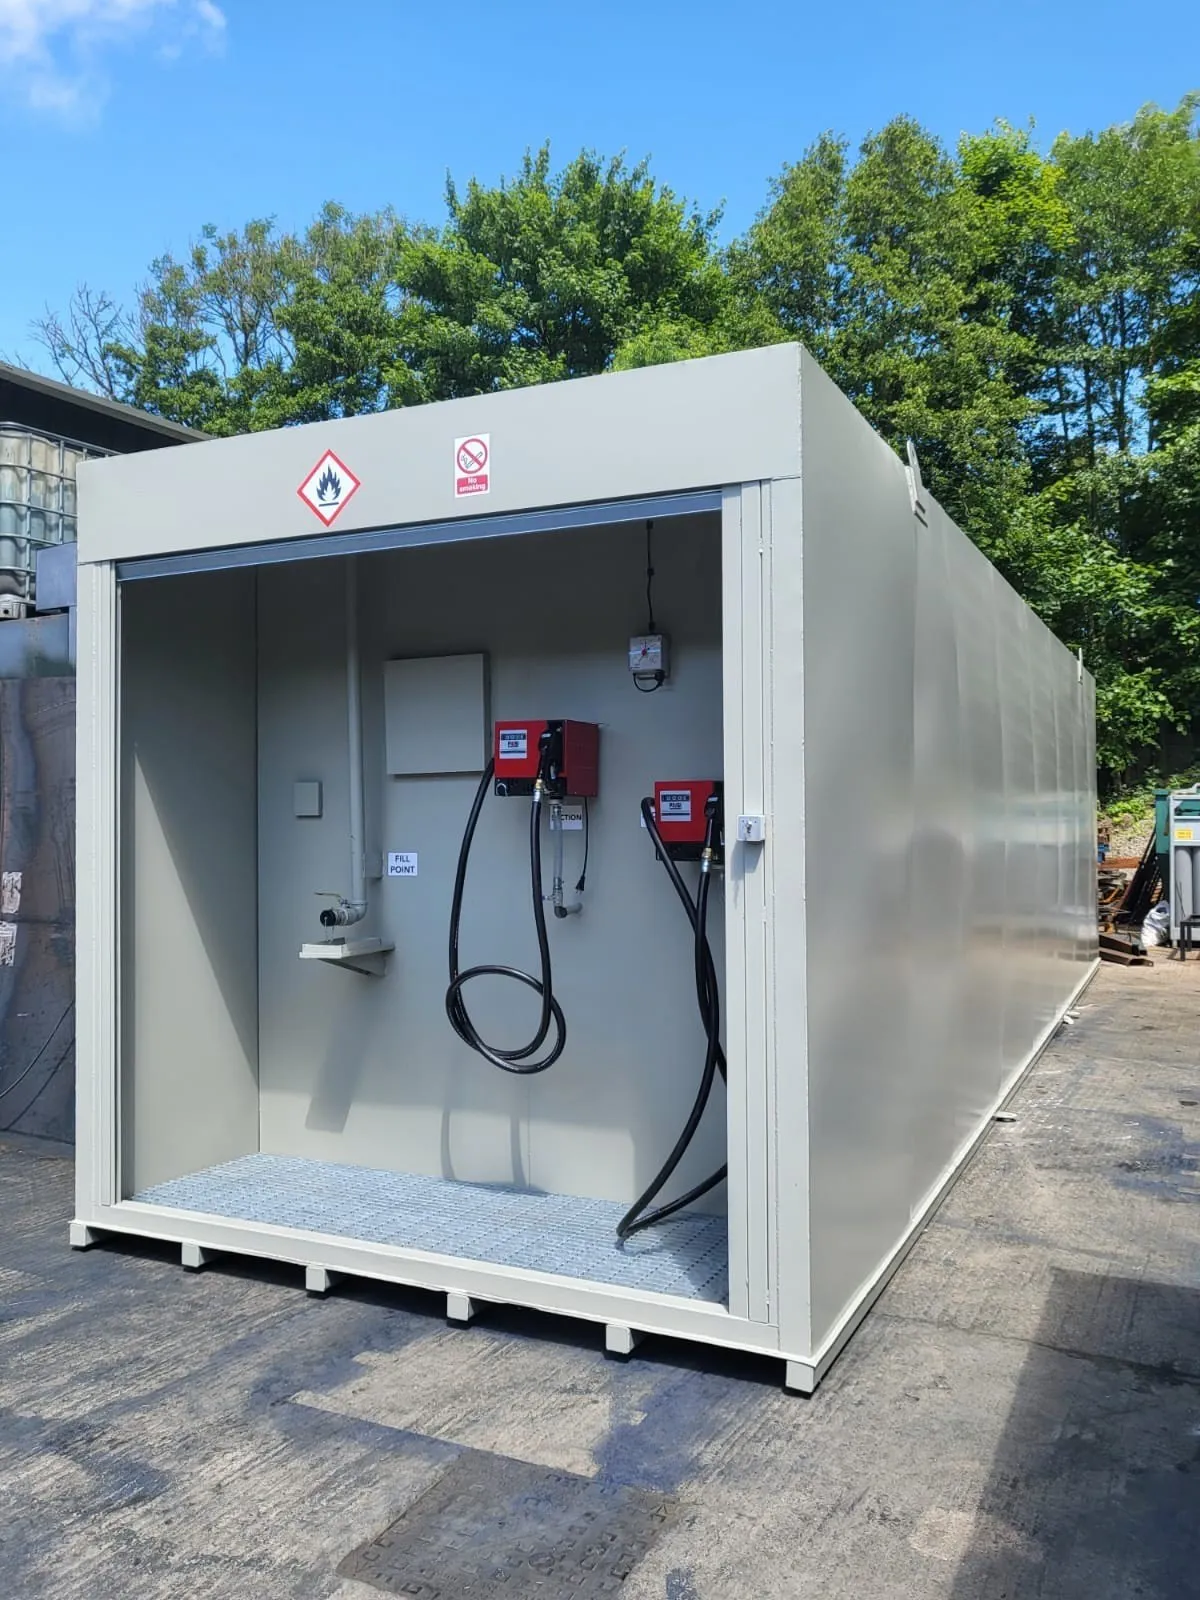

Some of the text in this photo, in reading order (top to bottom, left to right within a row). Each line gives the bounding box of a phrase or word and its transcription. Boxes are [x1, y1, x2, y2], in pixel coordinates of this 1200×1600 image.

[459, 483, 486, 492] smoking
[552, 813, 582, 821] CTION
[395, 855, 410, 863] FILL
[390, 865, 415, 873] POINT
